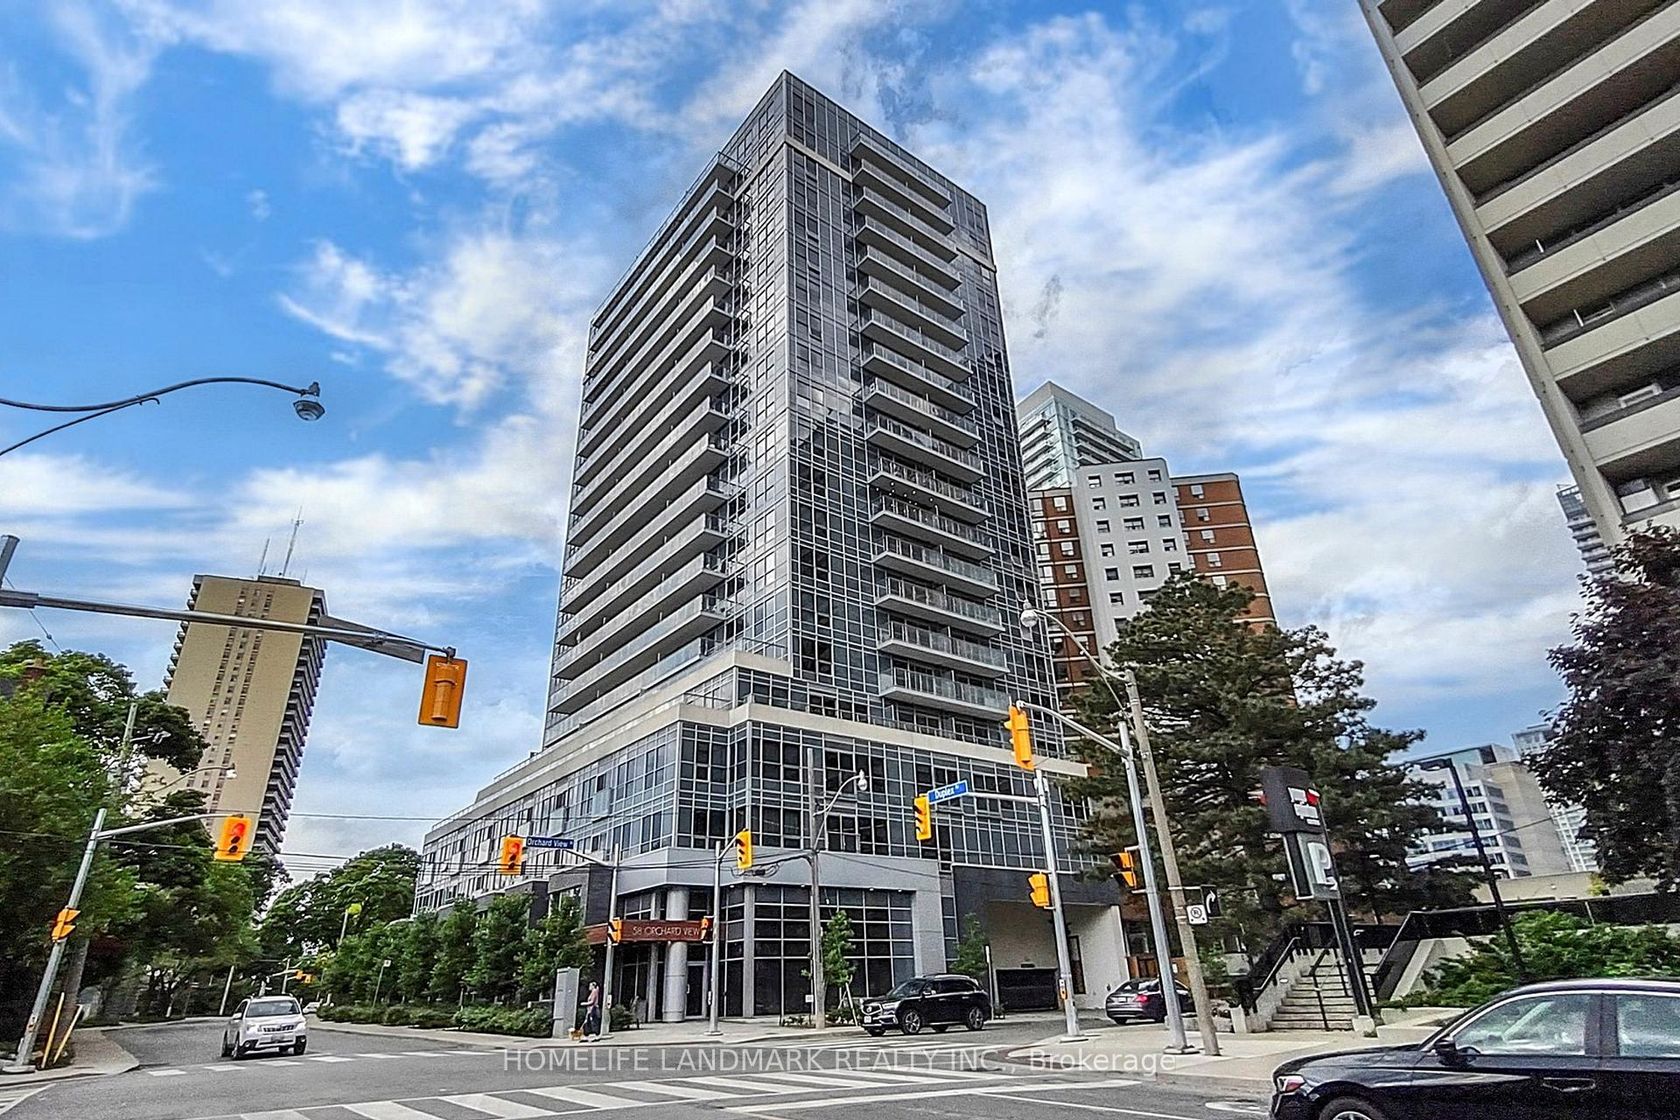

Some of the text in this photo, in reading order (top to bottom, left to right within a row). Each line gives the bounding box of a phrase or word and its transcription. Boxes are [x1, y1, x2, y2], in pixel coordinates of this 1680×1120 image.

[934, 787, 955, 799] Duplex
[527, 838, 553, 847] Orchard
[553, 840, 569, 848] View
[632, 926, 700, 936] 58 ORCHARD VIEW
